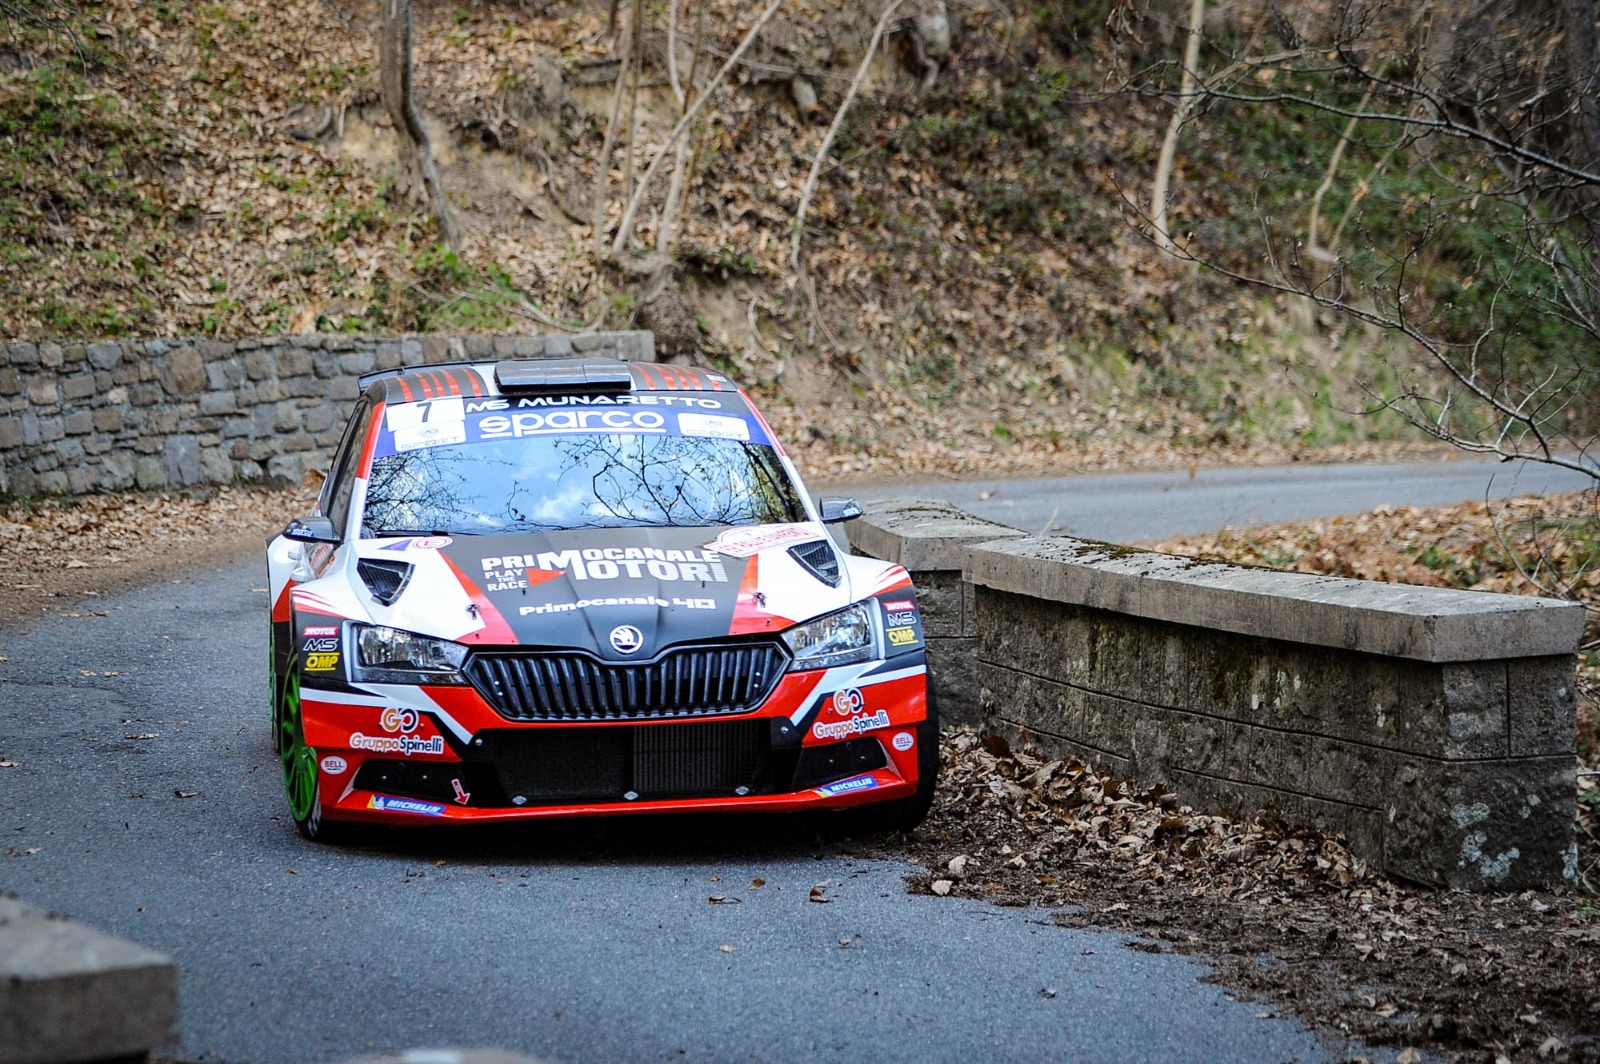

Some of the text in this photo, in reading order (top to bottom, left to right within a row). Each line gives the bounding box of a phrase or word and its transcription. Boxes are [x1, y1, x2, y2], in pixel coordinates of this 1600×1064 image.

[466, 395, 722, 413] MS MUNARETTO
[416, 401, 433, 424] 7
[479, 409, 665, 438] sparco
[484, 568, 524, 579] PLAY
[487, 580, 529, 592] RACE
[519, 596, 670, 616] Primocanale
[887, 611, 917, 627] MS
[303, 626, 337, 636] MOTUL
[888, 628, 916, 643] OMP
[302, 638, 339, 651] MS
[306, 655, 339, 668] OMP
[895, 736, 912, 745] BELL
[324, 760, 345, 768] BELL
[830, 777, 873, 792] MICHELIN
[387, 798, 442, 812] MICHELIN
